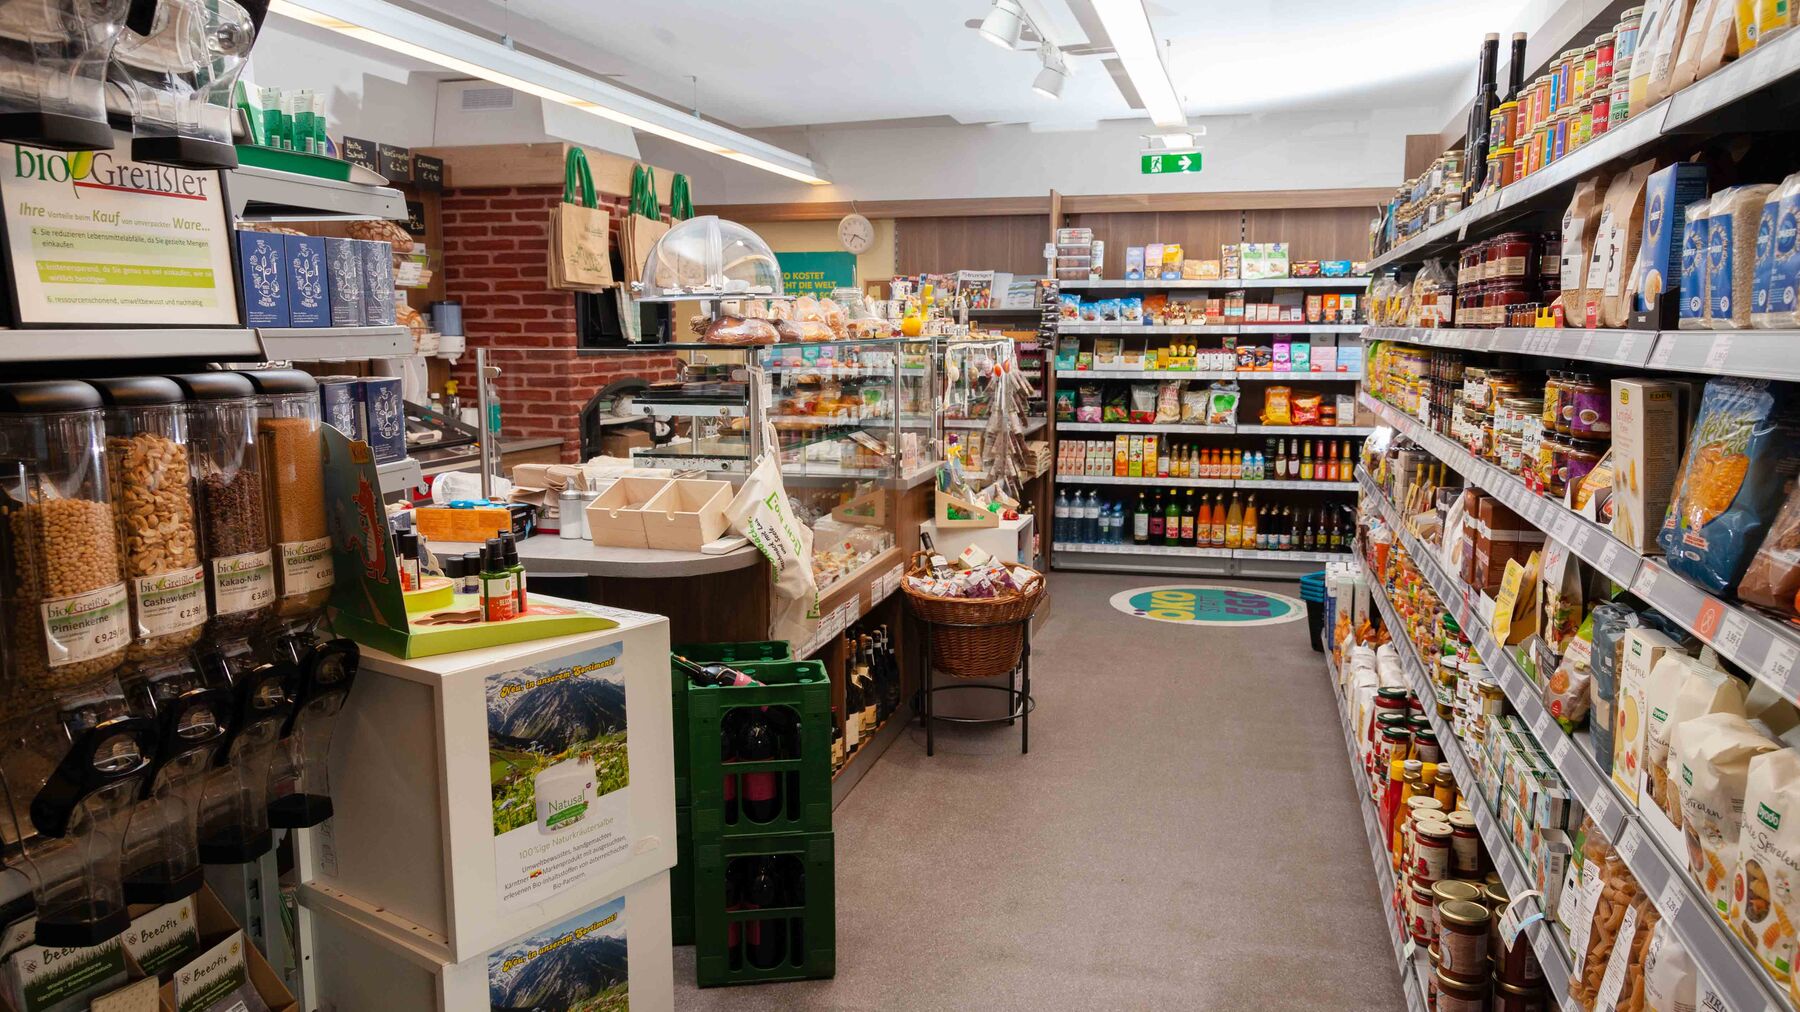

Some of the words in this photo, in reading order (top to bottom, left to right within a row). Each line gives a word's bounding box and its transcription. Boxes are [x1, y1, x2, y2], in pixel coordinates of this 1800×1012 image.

[15, 145, 70, 183] bio
[91, 152, 208, 196] Greißler
[19, 202, 46, 217] Ihre
[47, 210, 74, 221] Vorteile
[92, 209, 121, 226] Kauf
[172, 217, 210, 231] Ware...
[40, 228, 51, 236] Sie
[51, 230, 86, 240] reduzieren
[793, 272, 824, 280] KOSTET
[283, 545, 298, 557] bio
[217, 560, 233, 573] bio
[141, 579, 160, 593] bio
[219, 574, 262, 588] Kakao-Nibs
[143, 590, 197, 607] Cashewkerne
[48, 603, 69, 618] bio
[180, 610, 186, 619] €
[51, 614, 109, 634] Pinienkerne
[95, 635, 101, 644] €
[525, 680, 535, 690] in
[536, 670, 571, 687] unserem
[572, 656, 616, 677] Sortiment!
[548, 788, 585, 814] Natusal
[1759, 806, 1780, 827] byodo
[551, 816, 614, 848] Naturkräutersalbe
[572, 831, 612, 852] handgemachtes
[1757, 832, 1800, 872] Spiralen
[503, 884, 532, 901] erlesenen
[578, 861, 589, 870] von
[589, 842, 629, 865] österreichischen
[504, 875, 530, 891] Kärntner
[542, 852, 583, 874] Markenprodukt
[583, 848, 592, 857] mit
[140, 919, 178, 943] Beeofix
[527, 950, 538, 960] in
[538, 934, 573, 956] unserem
[574, 911, 618, 939] Sortiment!
[42, 946, 77, 965] Beeo
[192, 955, 228, 982] Beeofix
